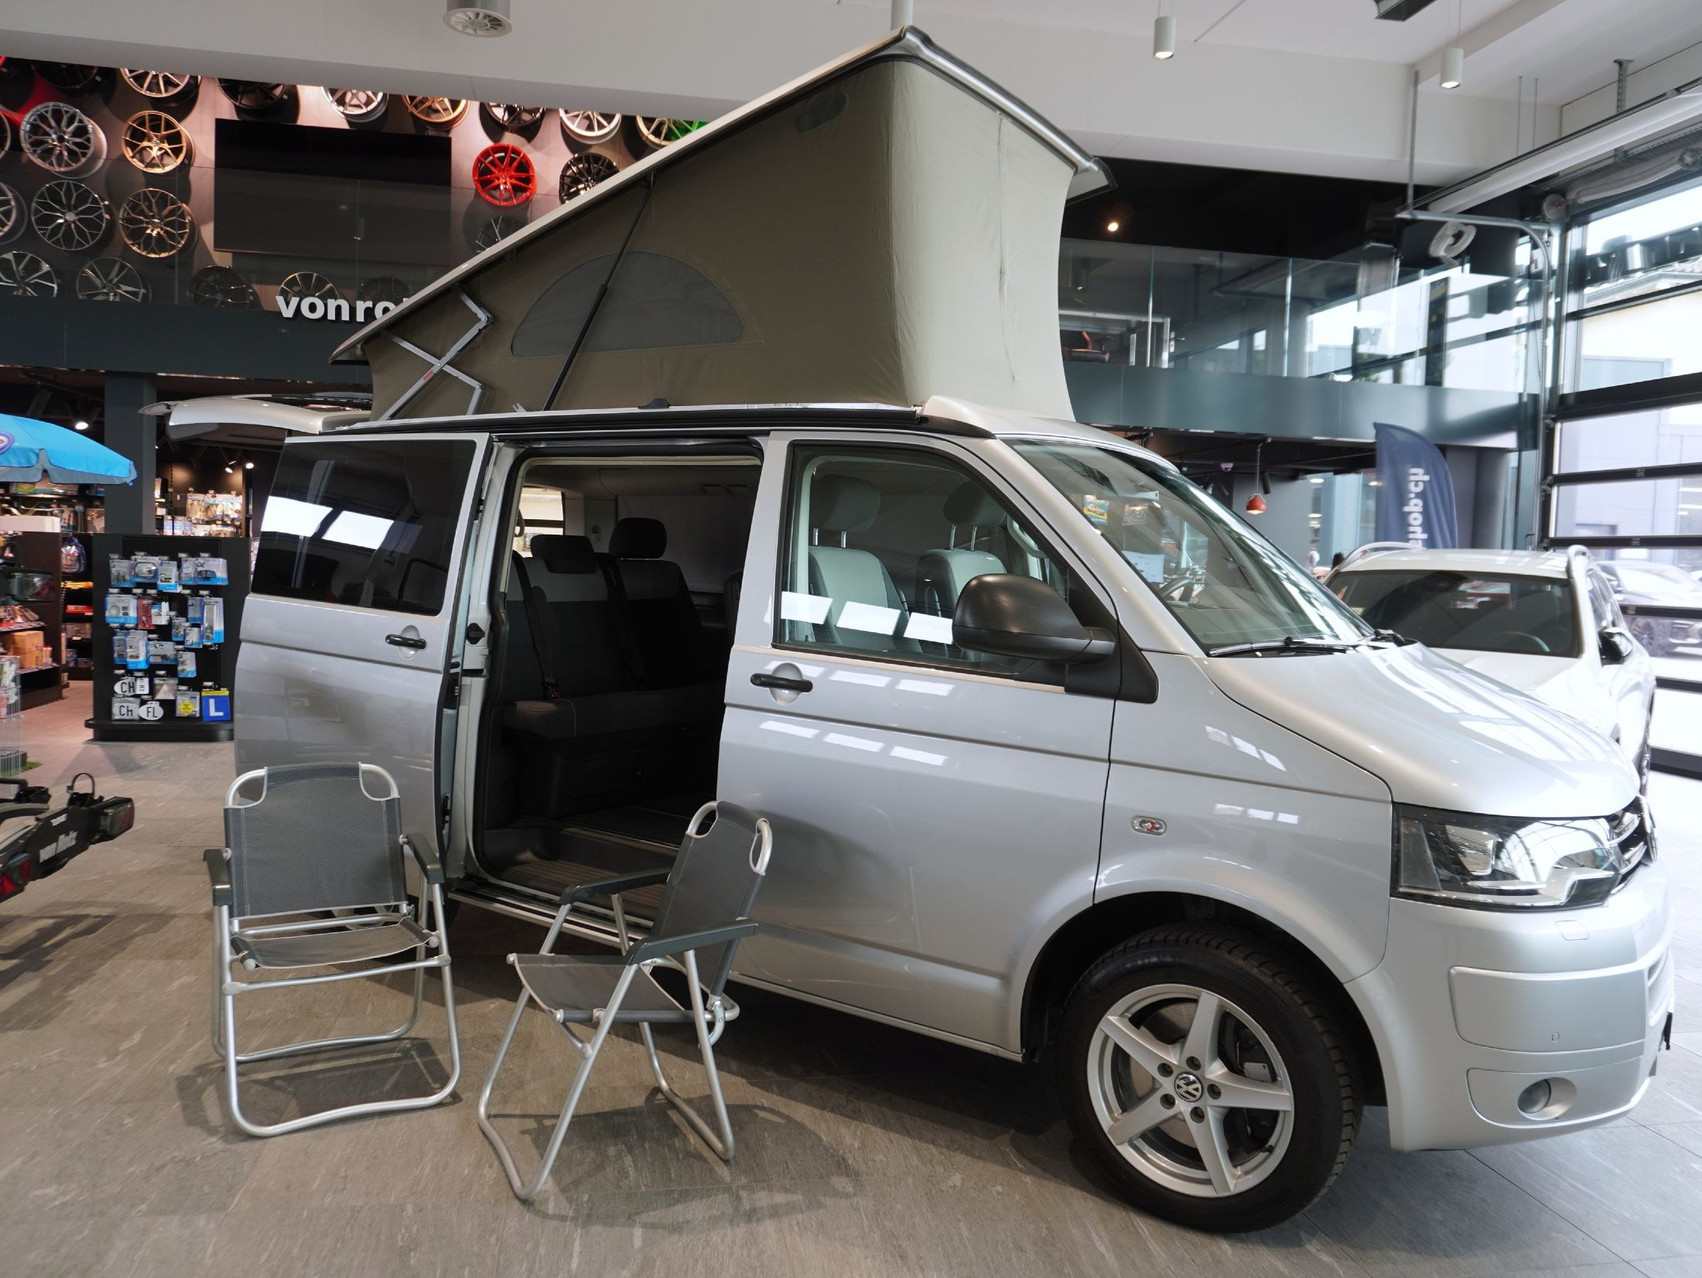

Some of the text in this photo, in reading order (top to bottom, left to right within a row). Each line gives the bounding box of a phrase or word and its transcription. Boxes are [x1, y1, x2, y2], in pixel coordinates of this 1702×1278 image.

[120, 681, 136, 693] CH
[146, 706, 158, 718] FL
[208, 698, 224, 717] L
